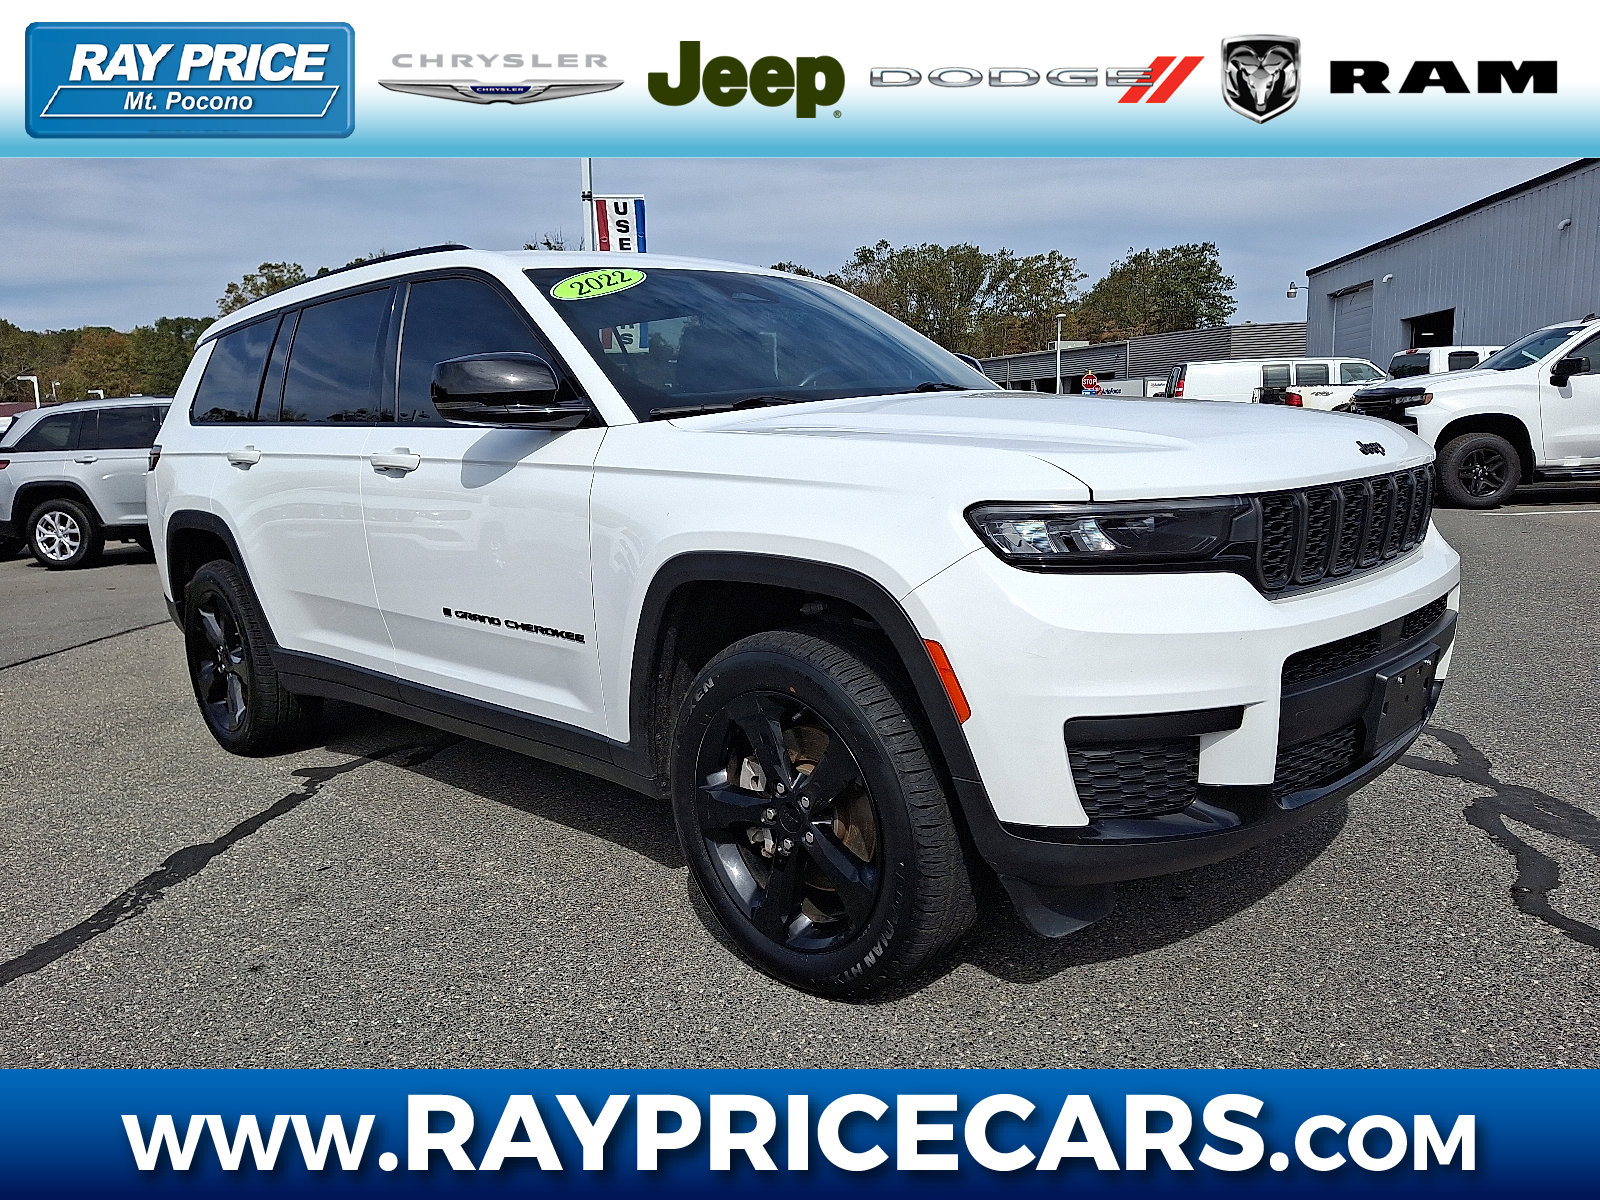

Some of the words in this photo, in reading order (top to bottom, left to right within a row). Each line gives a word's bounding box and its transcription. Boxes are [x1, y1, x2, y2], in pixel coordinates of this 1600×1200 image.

[569, 270, 633, 296] 2022
[1355, 440, 1386, 456] Jeep
[454, 610, 502, 626] GRAND
[504, 619, 585, 644] CHEROKEE
